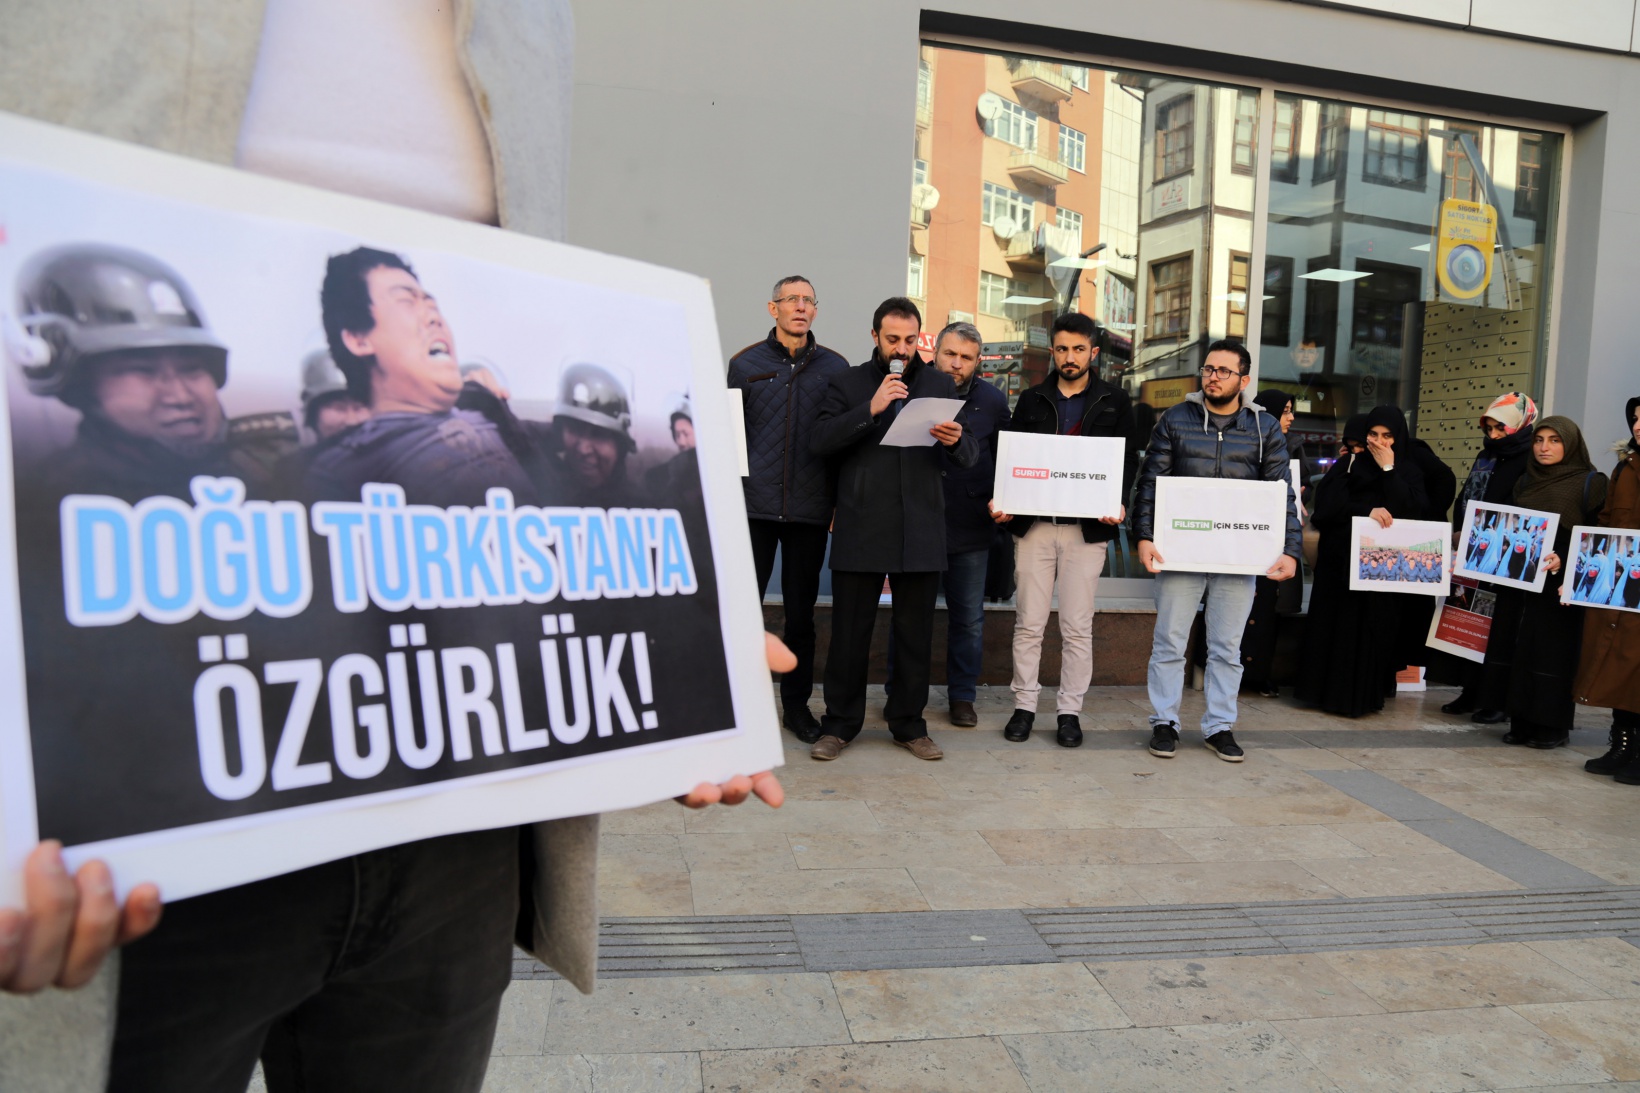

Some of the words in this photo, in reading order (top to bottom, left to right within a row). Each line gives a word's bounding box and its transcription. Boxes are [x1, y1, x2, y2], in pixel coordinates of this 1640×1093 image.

[1069, 472, 1087, 480] SES
[1088, 473, 1107, 481] VER
[61, 476, 312, 627] DOĞU
[311, 482, 698, 613] TÜRKİSTAN'A
[1251, 523, 1270, 531] VER
[193, 613, 659, 801] ÖZGÜRLÜK!
